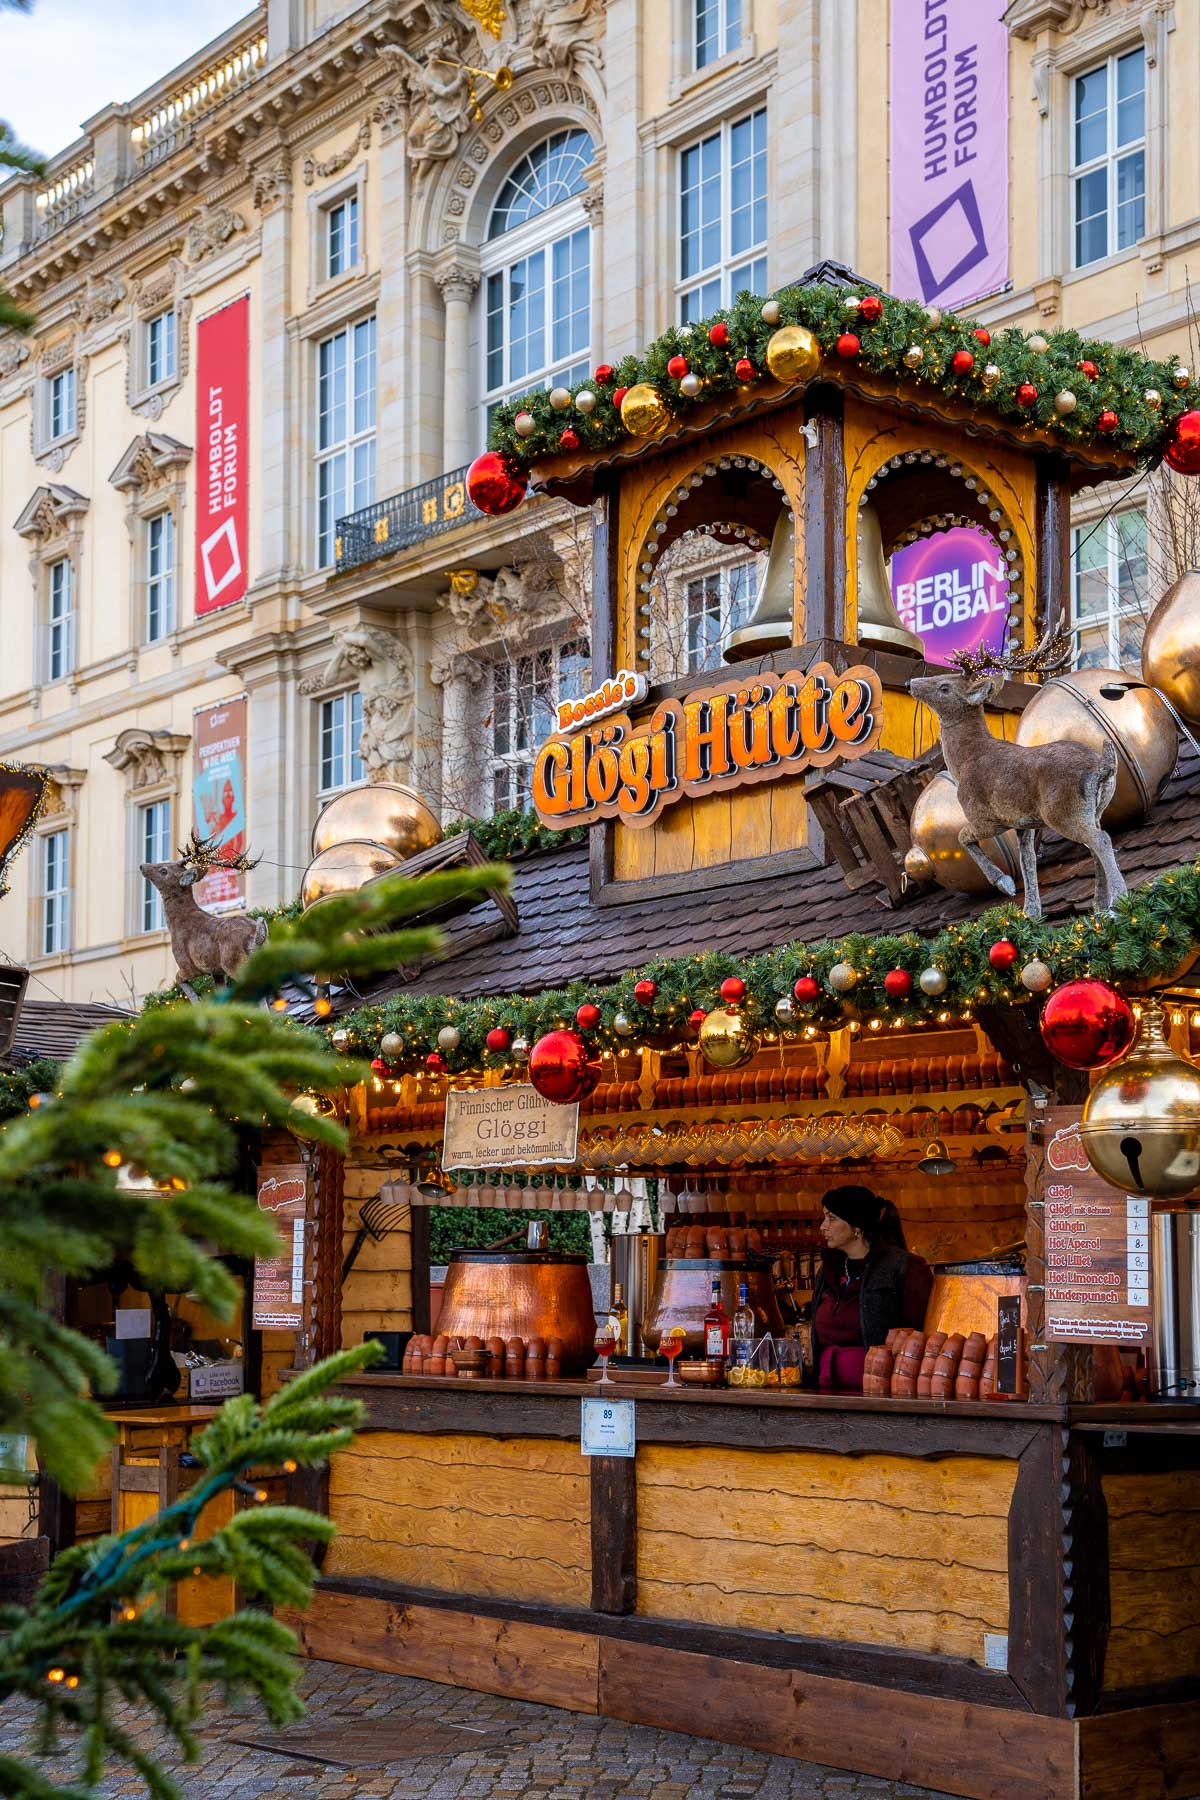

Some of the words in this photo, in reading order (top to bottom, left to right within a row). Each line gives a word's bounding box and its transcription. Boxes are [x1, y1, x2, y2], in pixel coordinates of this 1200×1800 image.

[924, 0, 947, 181] HUMBOLDT
[954, 44, 977, 168] FORUM
[209, 386, 222, 515] HUMBOLDT
[224, 423, 237, 508] FORUM
[897, 558, 1005, 611] BERLIN
[899, 584, 1005, 634] GLOBAL
[558, 674, 637, 729] Bossle's
[532, 711, 672, 816] Glögi
[683, 676, 868, 783] Hütte
[459, 1098, 514, 1115] Finnischer
[517, 1094, 567, 1110] Glühw
[476, 1114, 547, 1139] Glöggi
[452, 1150, 473, 1160] warm,
[475, 1147, 499, 1158] lecker
[501, 1145, 515, 1156] und
[517, 1141, 563, 1155] bekömmlich
[1050, 1138, 1087, 1167] Glög
[1049, 1238, 1065, 1249] Hot
[1068, 1238, 1100, 1251] Aperol
[1049, 1255, 1065, 1266] Hot
[1049, 1271, 1065, 1283] Hot
[1068, 1272, 1120, 1285] Limoncello
[1049, 1289, 1118, 1303] Kinderpunsch
[210, 1376, 240, 1386] Facebook
[603, 1409, 613, 1419] 89
